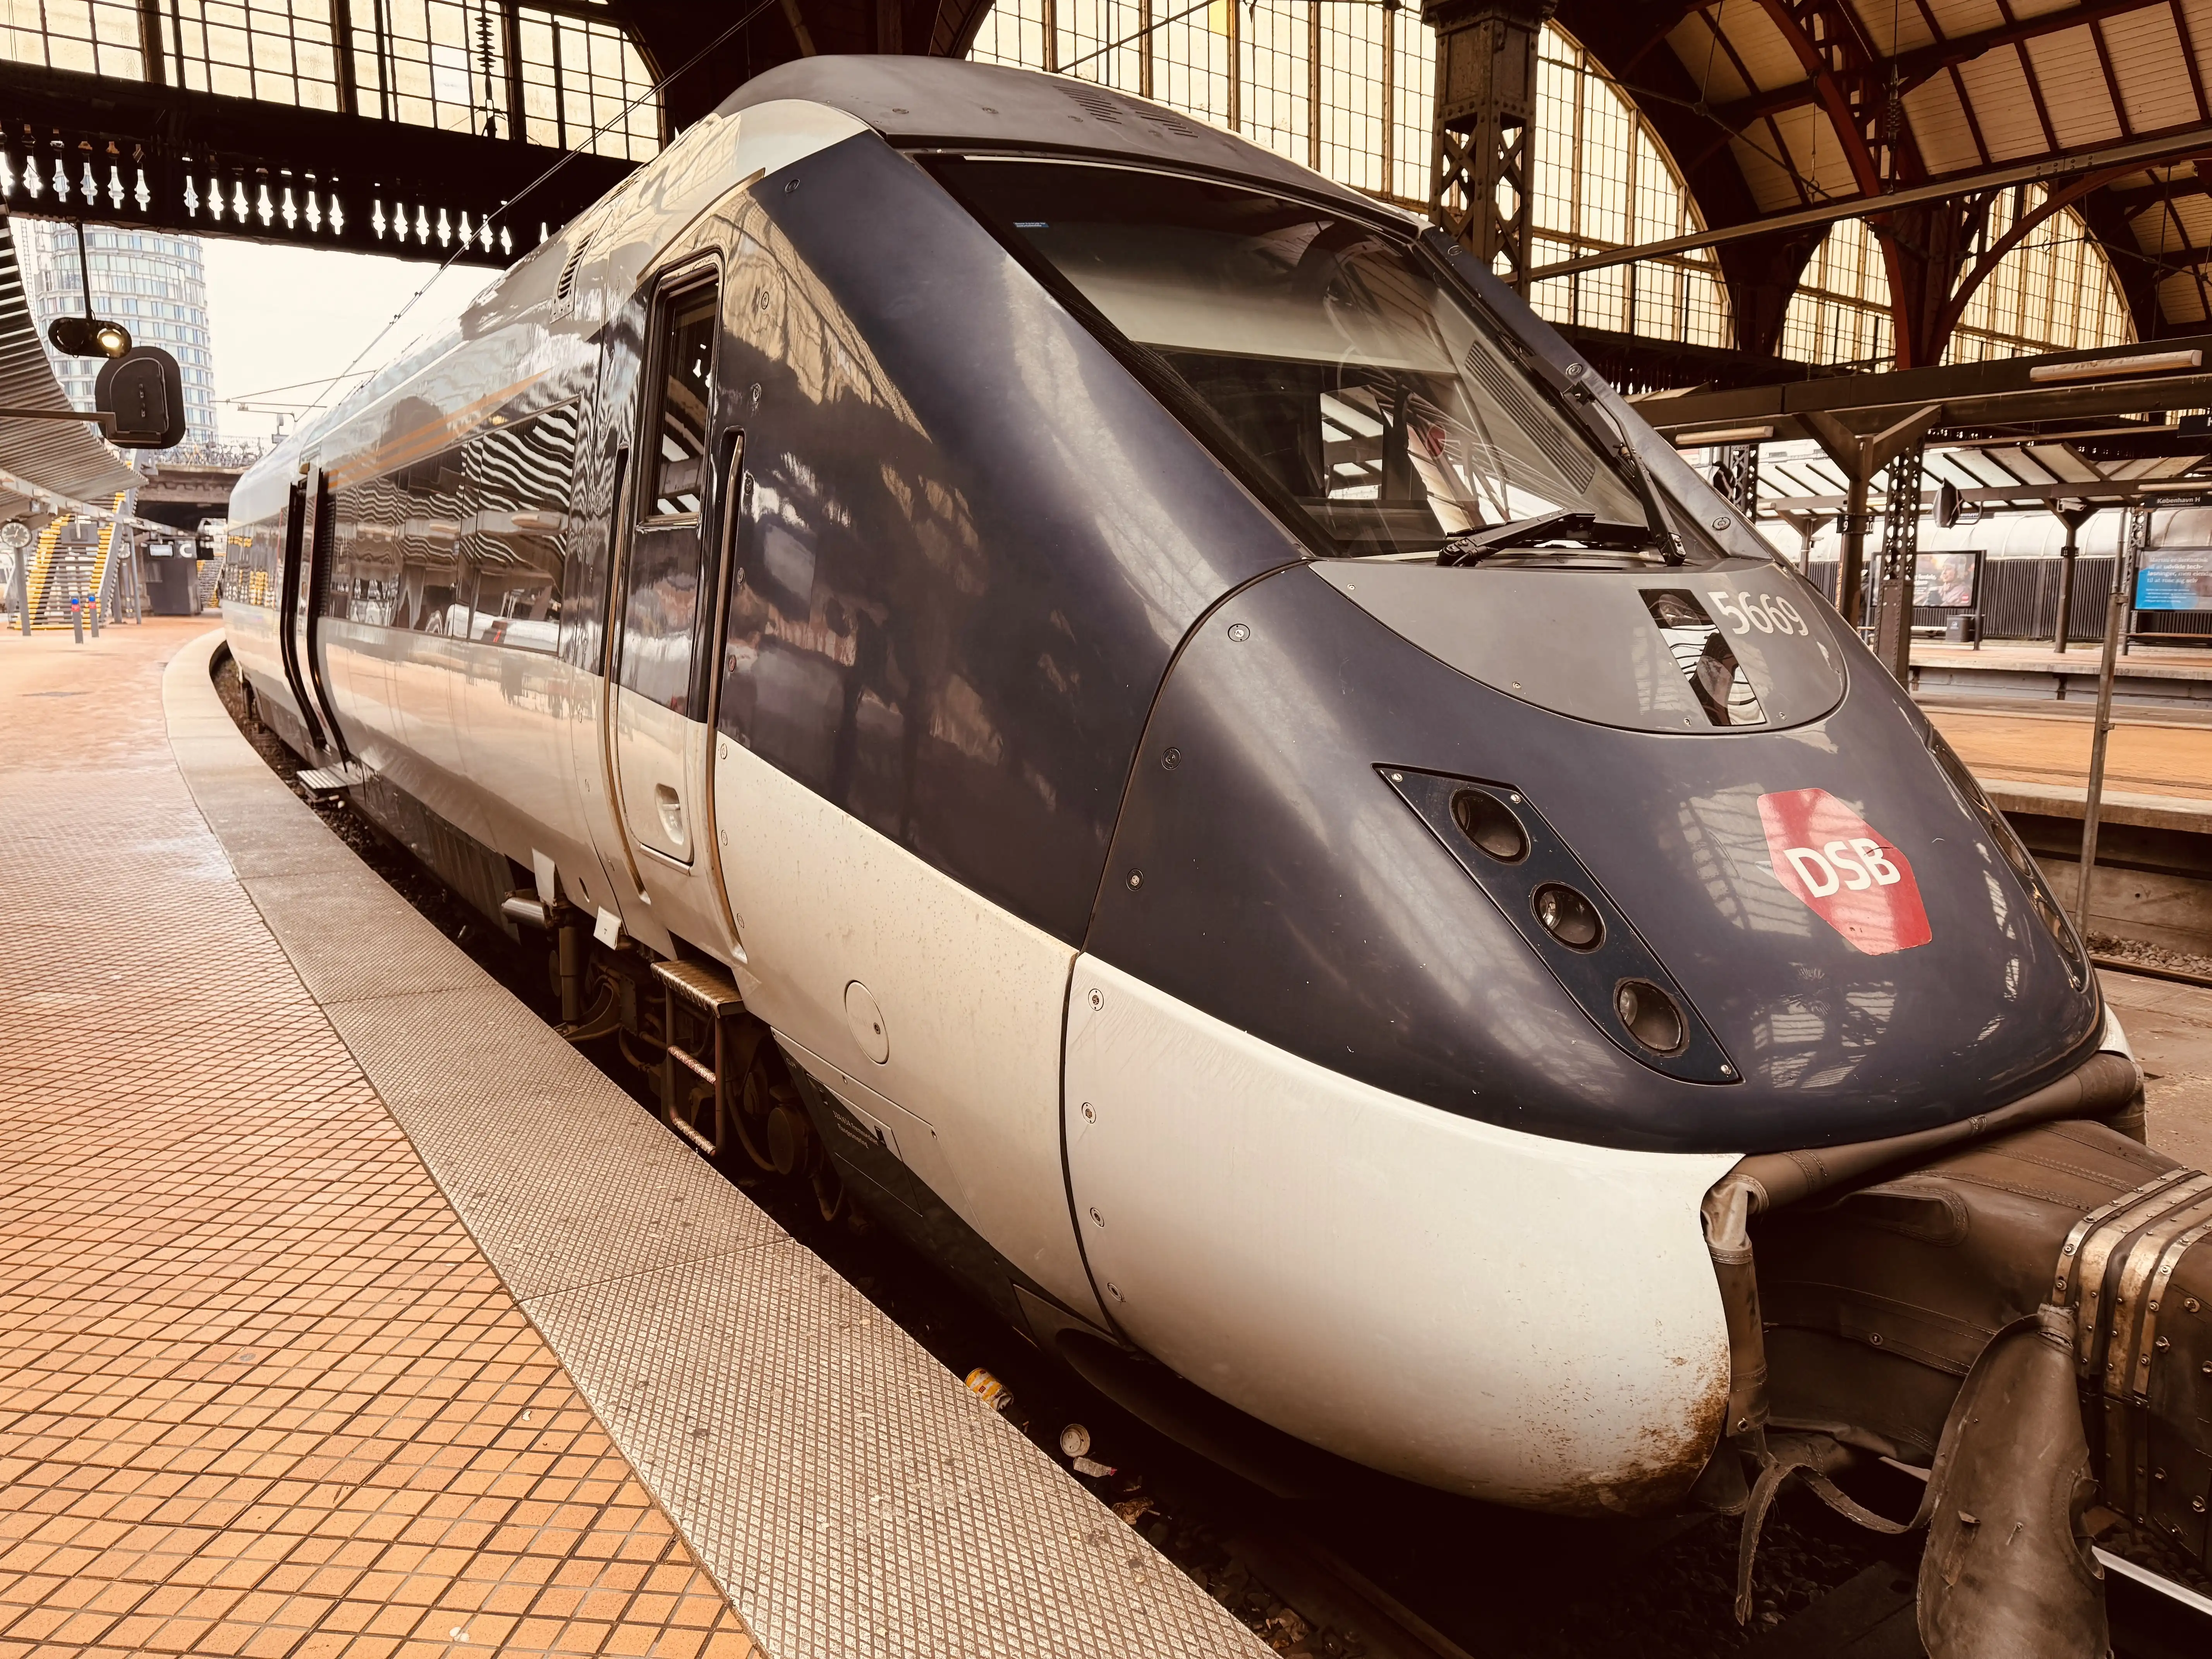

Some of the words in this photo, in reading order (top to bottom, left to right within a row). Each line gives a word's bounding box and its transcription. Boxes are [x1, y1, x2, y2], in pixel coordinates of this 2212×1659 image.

[1843, 520, 1848, 532] 9
[1865, 521, 1874, 532] 10
[180, 543, 192, 558] C
[1707, 591, 1809, 636] 5669
[1783, 838, 1901, 898] DSB
